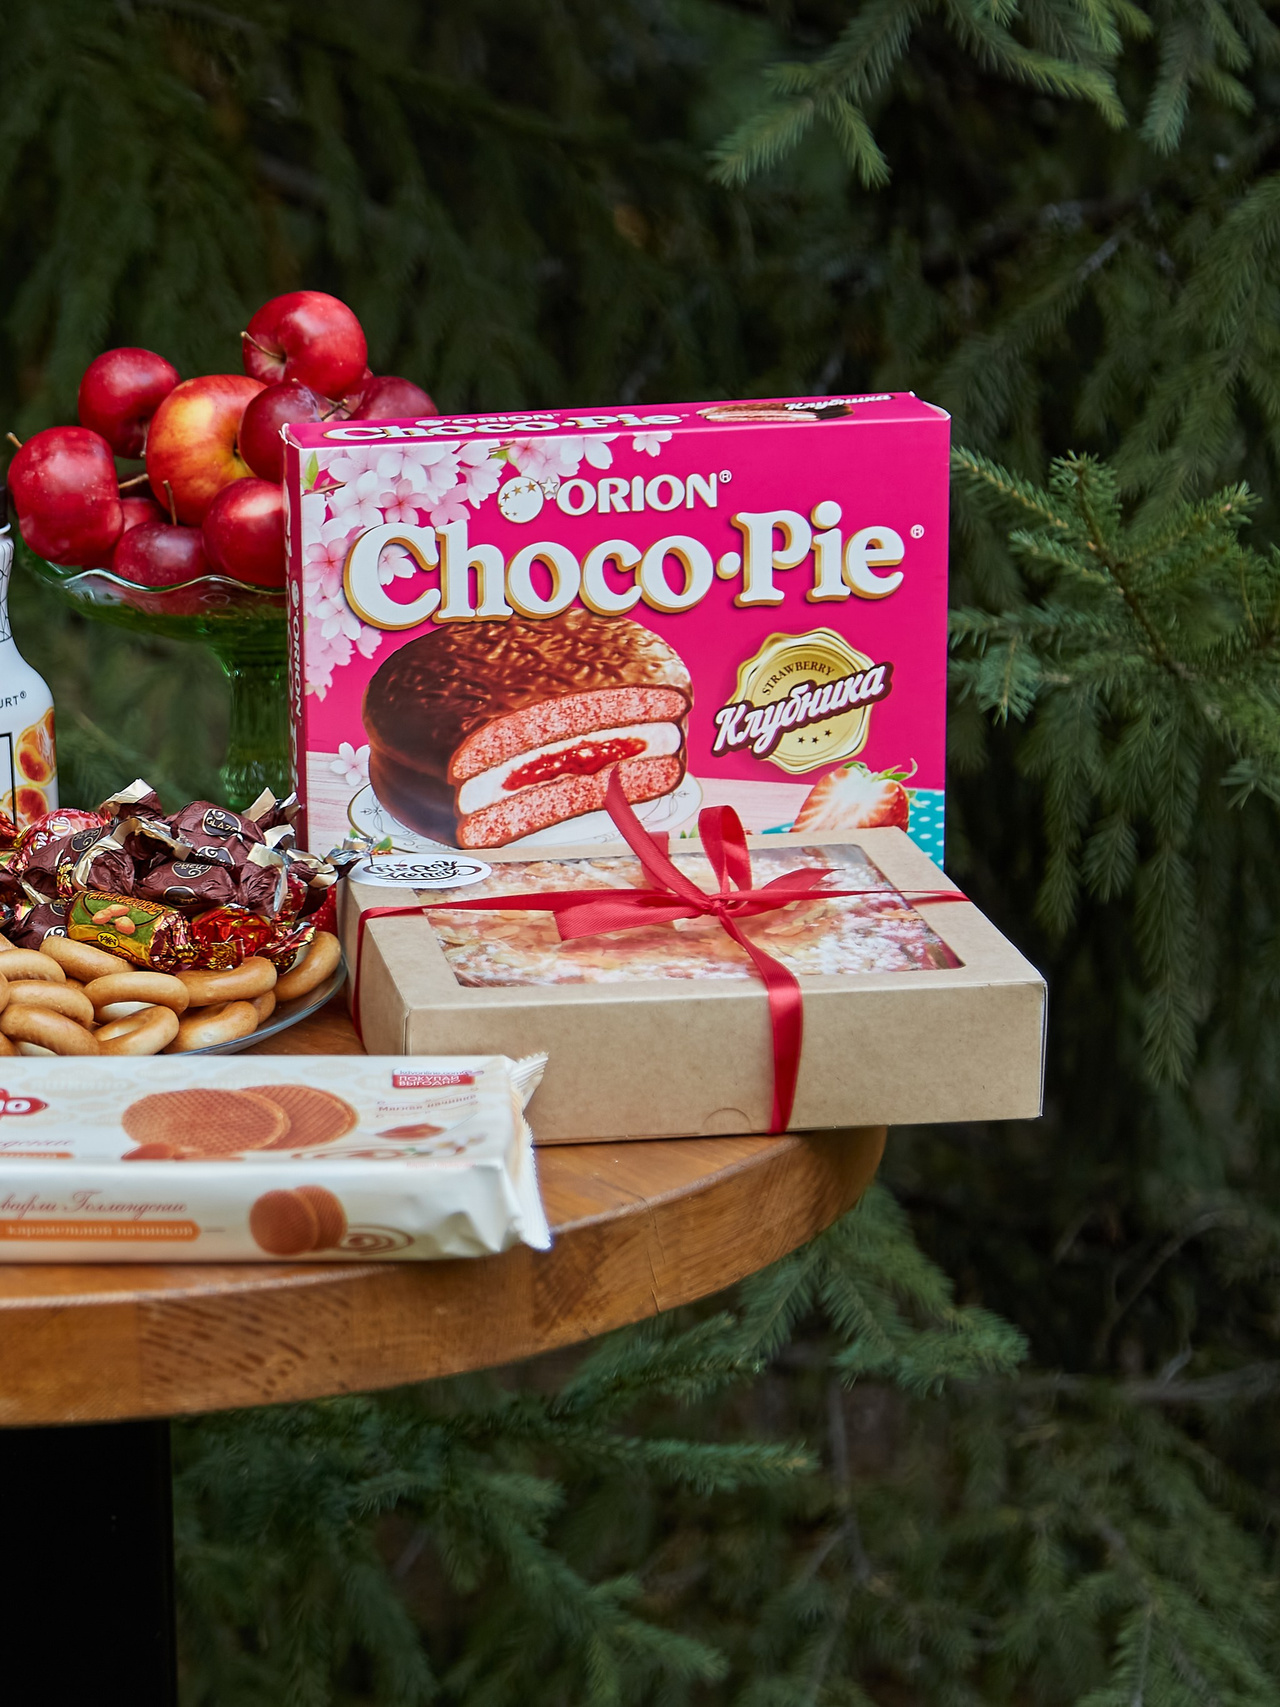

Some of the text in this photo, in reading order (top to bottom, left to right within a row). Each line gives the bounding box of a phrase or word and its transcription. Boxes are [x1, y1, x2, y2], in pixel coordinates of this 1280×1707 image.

[556, 472, 718, 515] ORION
[292, 616, 302, 717] ORION
[762, 661, 835, 695] STRAWBERRY
[713, 665, 887, 754] Клубника
